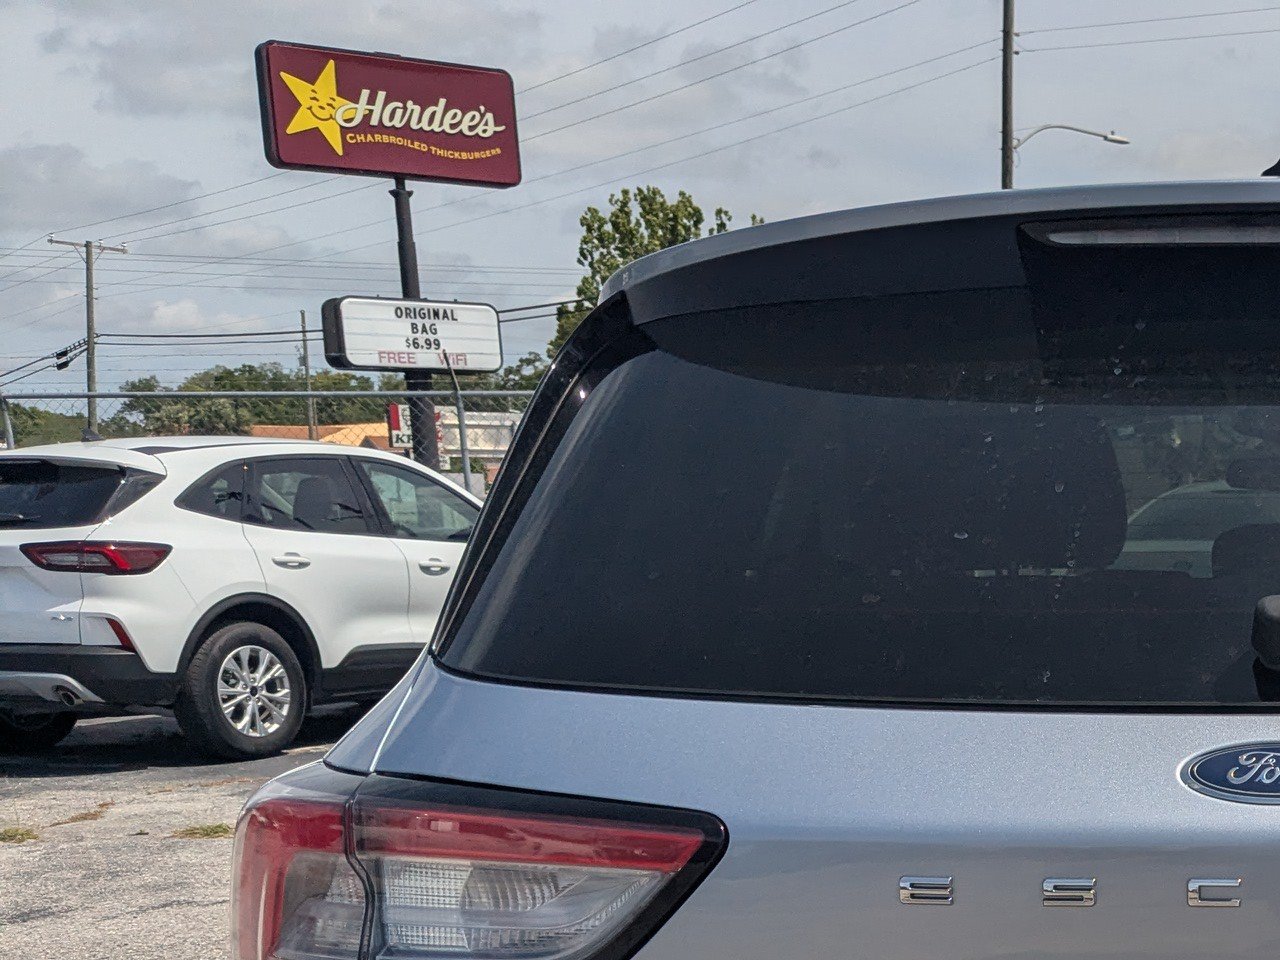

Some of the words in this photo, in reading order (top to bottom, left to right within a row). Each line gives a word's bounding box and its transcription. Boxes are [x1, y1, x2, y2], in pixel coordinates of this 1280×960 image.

[335, 89, 506, 138] Hardee's
[346, 133, 429, 151] CHARBROILED
[430, 146, 502, 160] THICKBURGERS
[394, 306, 458, 321] ORIGINAL
[410, 322, 438, 335] BAG
[405, 337, 441, 350] $6.99
[377, 350, 417, 365] FREE
